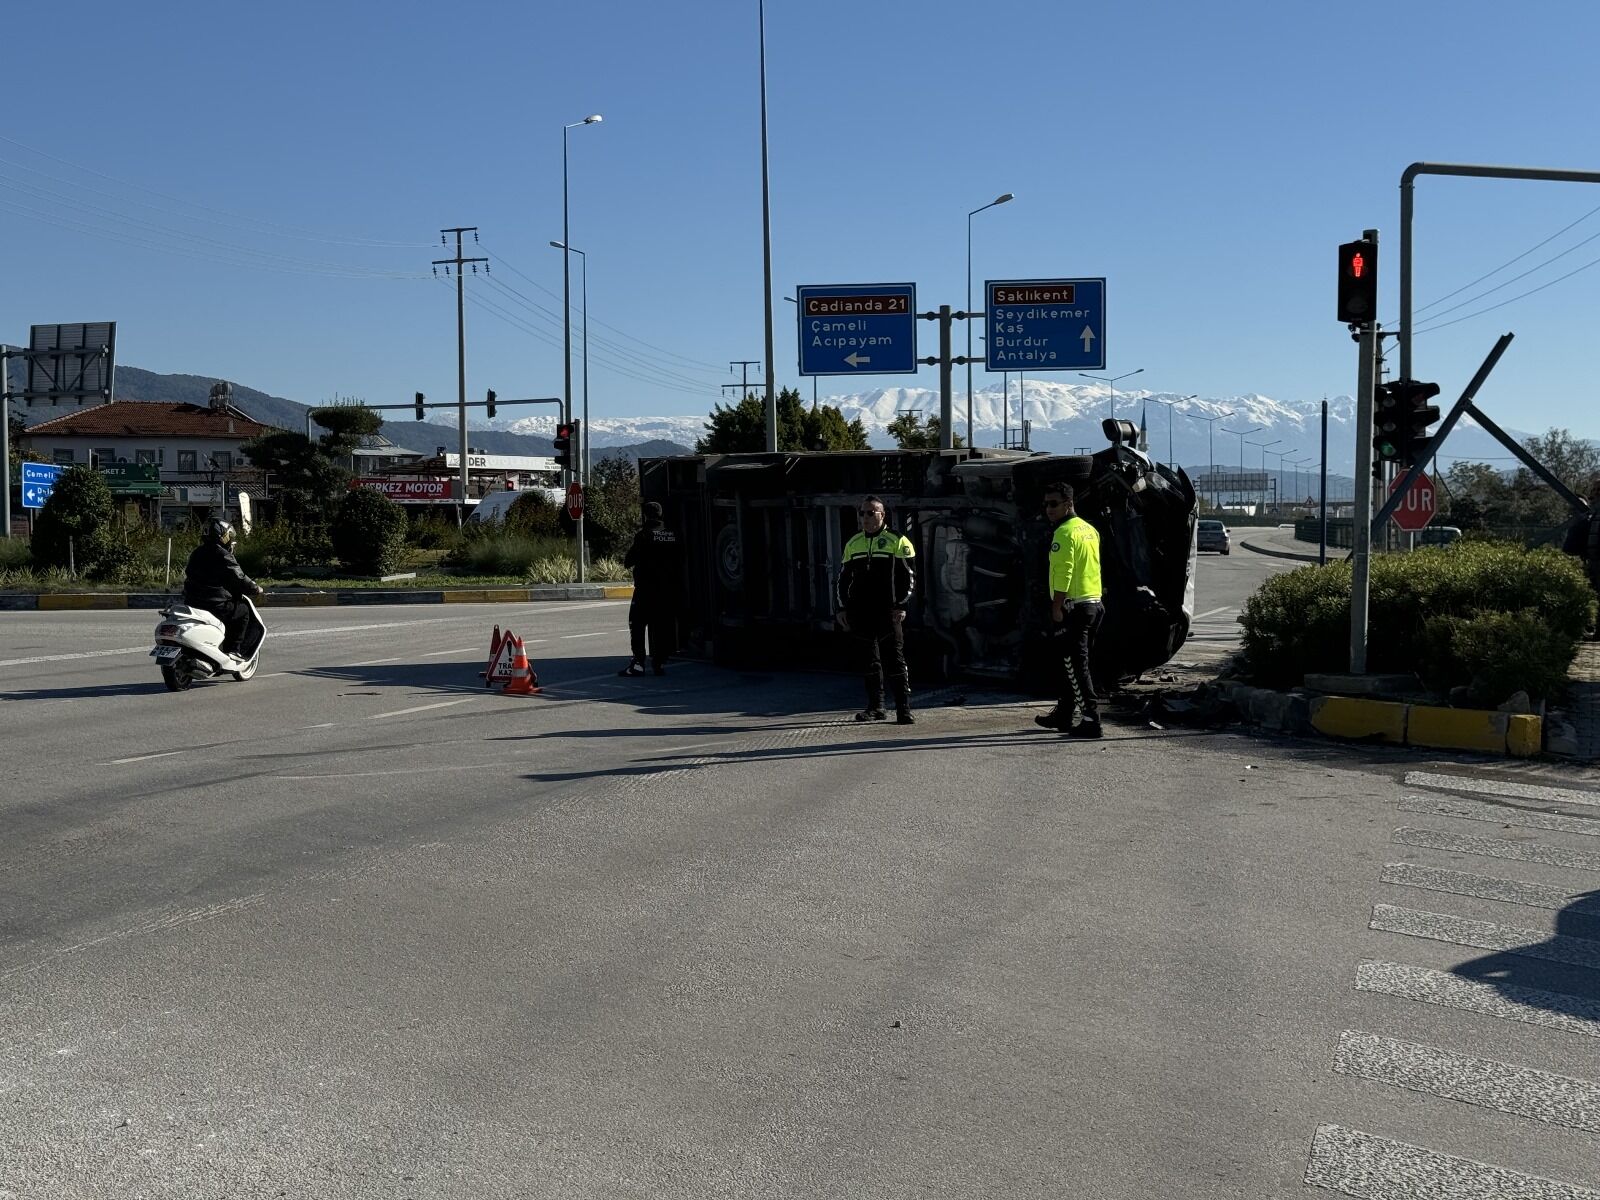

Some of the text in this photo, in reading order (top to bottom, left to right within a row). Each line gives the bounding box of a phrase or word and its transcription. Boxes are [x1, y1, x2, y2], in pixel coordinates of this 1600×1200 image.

[997, 289, 1068, 301] Saklıkent
[809, 298, 905, 312] Cadianda 21
[995, 308, 1090, 322] Seydikemer
[811, 319, 866, 333] Çameli
[995, 322, 1024, 334] Kaş
[812, 335, 892, 349] Acıpayam
[995, 336, 1048, 347] Burdur
[996, 349, 1057, 362] Antalya
[405, 483, 444, 493] MOTOR
[569, 493, 583, 509] DUR
